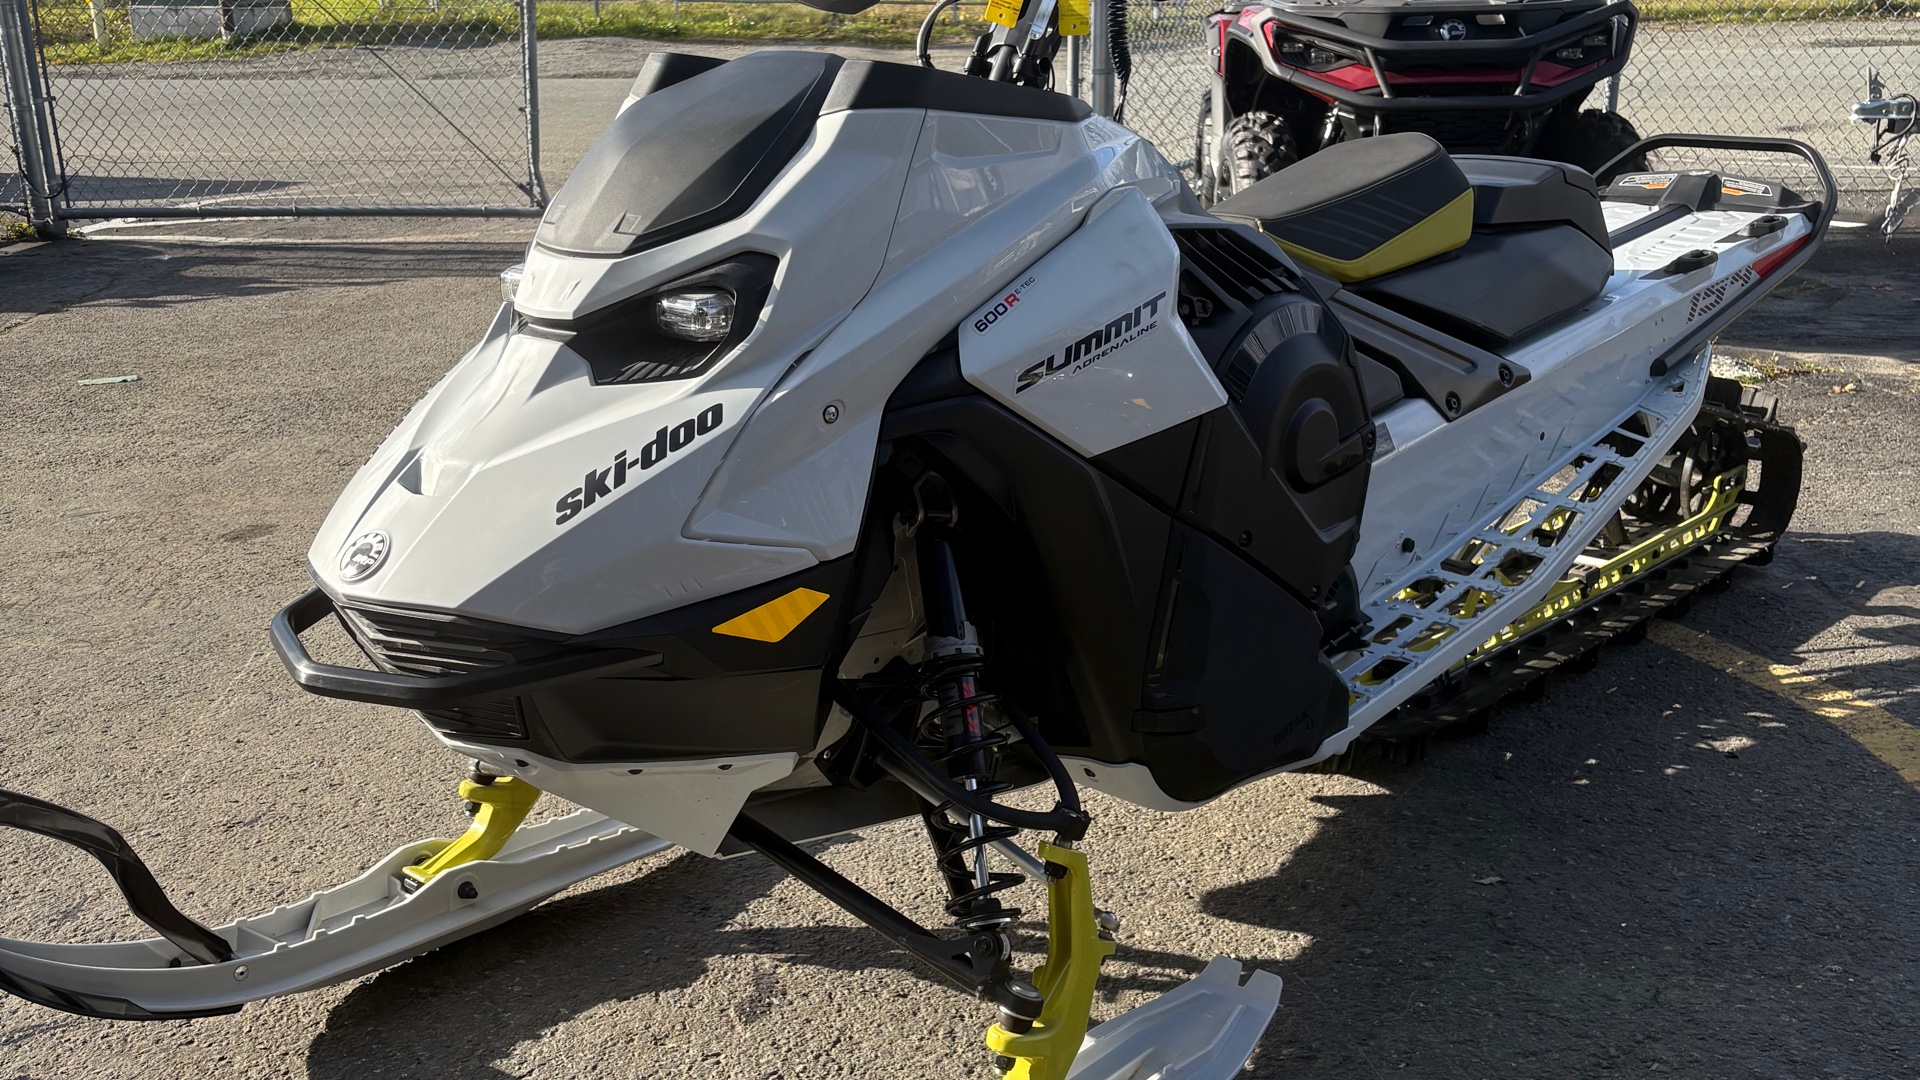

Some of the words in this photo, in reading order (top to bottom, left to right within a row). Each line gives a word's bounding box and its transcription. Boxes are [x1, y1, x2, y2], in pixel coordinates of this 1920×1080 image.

[974, 293, 1020, 333] 600R
[1014, 276, 1036, 295] E-TEC
[1015, 291, 1167, 395] SUMMIT
[1072, 320, 1157, 375] ADRENALINE
[555, 402, 724, 526] ski-doo
